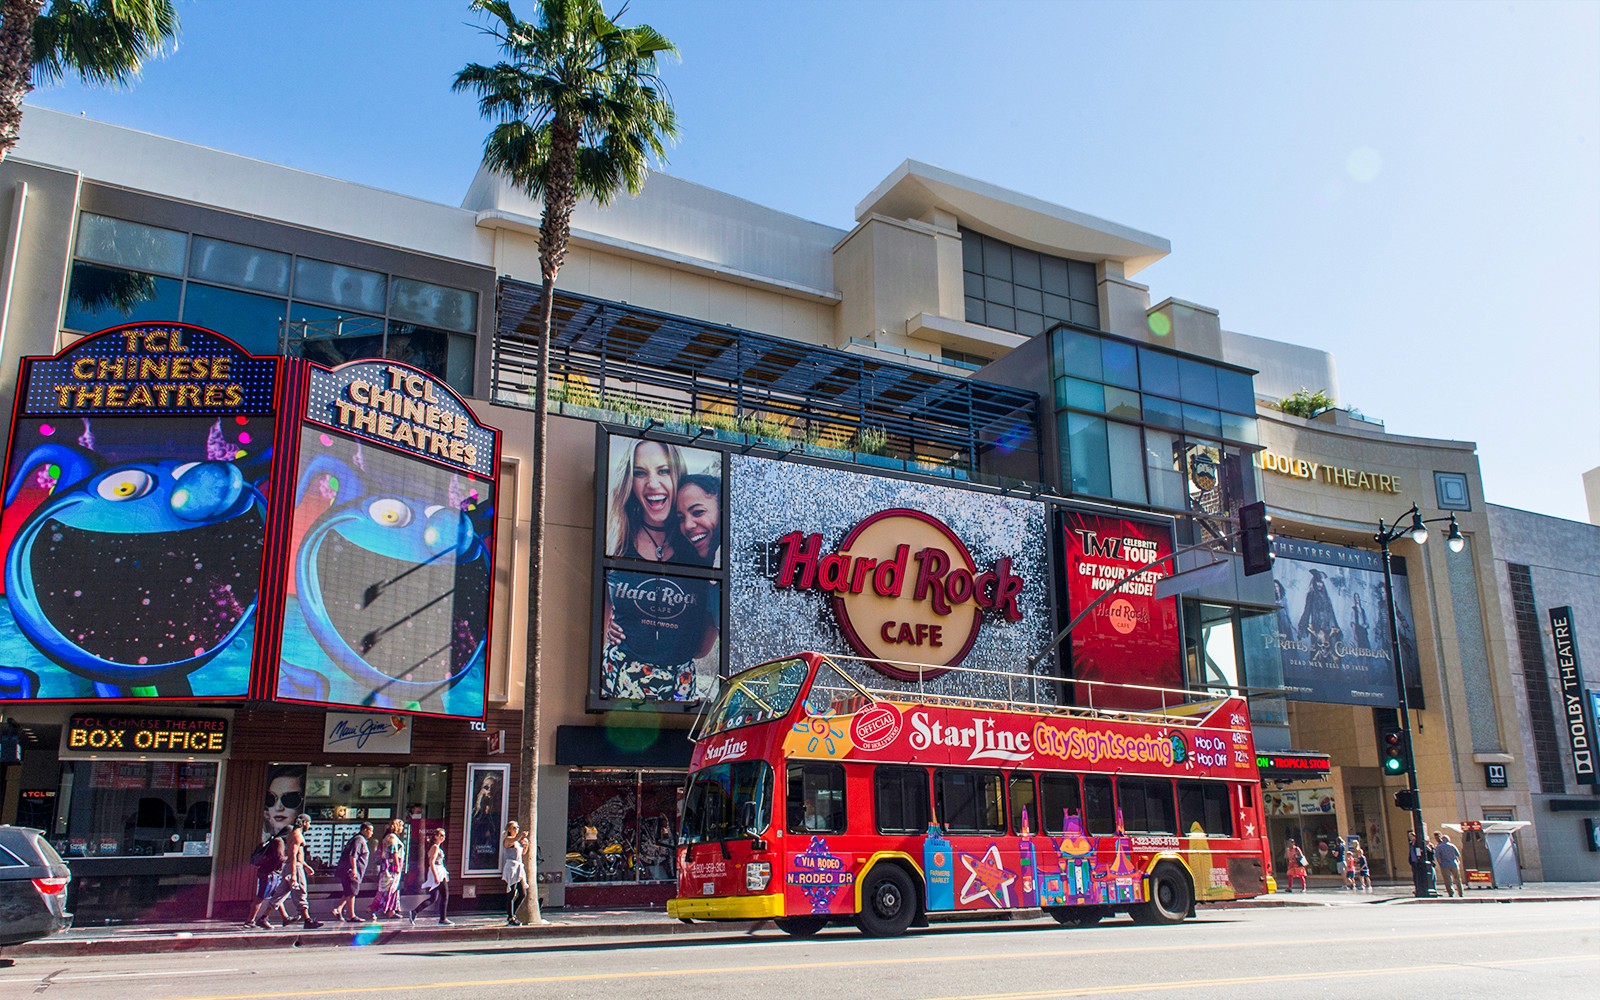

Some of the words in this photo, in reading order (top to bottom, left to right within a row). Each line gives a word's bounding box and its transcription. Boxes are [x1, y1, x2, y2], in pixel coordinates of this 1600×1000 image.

[122, 330, 188, 353] TCL
[72, 357, 231, 380] CHINESE
[54, 383, 243, 408] THEATRES
[388, 365, 438, 404] TCL
[350, 380, 468, 439] CHINESE
[335, 398, 477, 466] THEATRES
[1266, 451, 1318, 480] DOLBY
[1322, 464, 1402, 493] THEATRE
[1075, 528, 1125, 560] TMZ
[1123, 537, 1157, 550] CELEBRITY
[1123, 546, 1157, 564] TOUR
[1272, 541, 1331, 559] THEATRES
[1337, 551, 1360, 564] MAY
[776, 530, 910, 598] Hard
[915, 547, 1024, 622] Rock
[1079, 562, 1097, 576] GET
[1098, 564, 1125, 580] YOUR
[661, 587, 698, 606] Rock
[881, 620, 943, 647] CAFE
[1334, 641, 1391, 661] CARIBBEAN
[1554, 616, 1578, 690] THEATRE
[73, 717, 104, 728] TCL
[108, 718, 160, 729] CHINESE
[165, 719, 225, 731] THEATRES
[470, 721, 486, 732] TCL
[859, 714, 892, 737] OFFICIAL
[1566, 694, 1588, 749] DOLBY
[69, 729, 126, 748] BOX
[134, 730, 224, 750] OFFICE
[329, 719, 358, 739] Maui
[357, 718, 389, 749] Jim
[1195, 736, 1212, 750] Hop
[1213, 736, 1226, 750] On
[1197, 753, 1213, 767] Hop
[1214, 753, 1227, 766] Off
[1256, 757, 1269, 768] ON
[1274, 757, 1309, 769] TROPICAL
[801, 856, 815, 868] VIA
[817, 857, 840, 869] RODEO
[839, 873, 853, 883] DR
